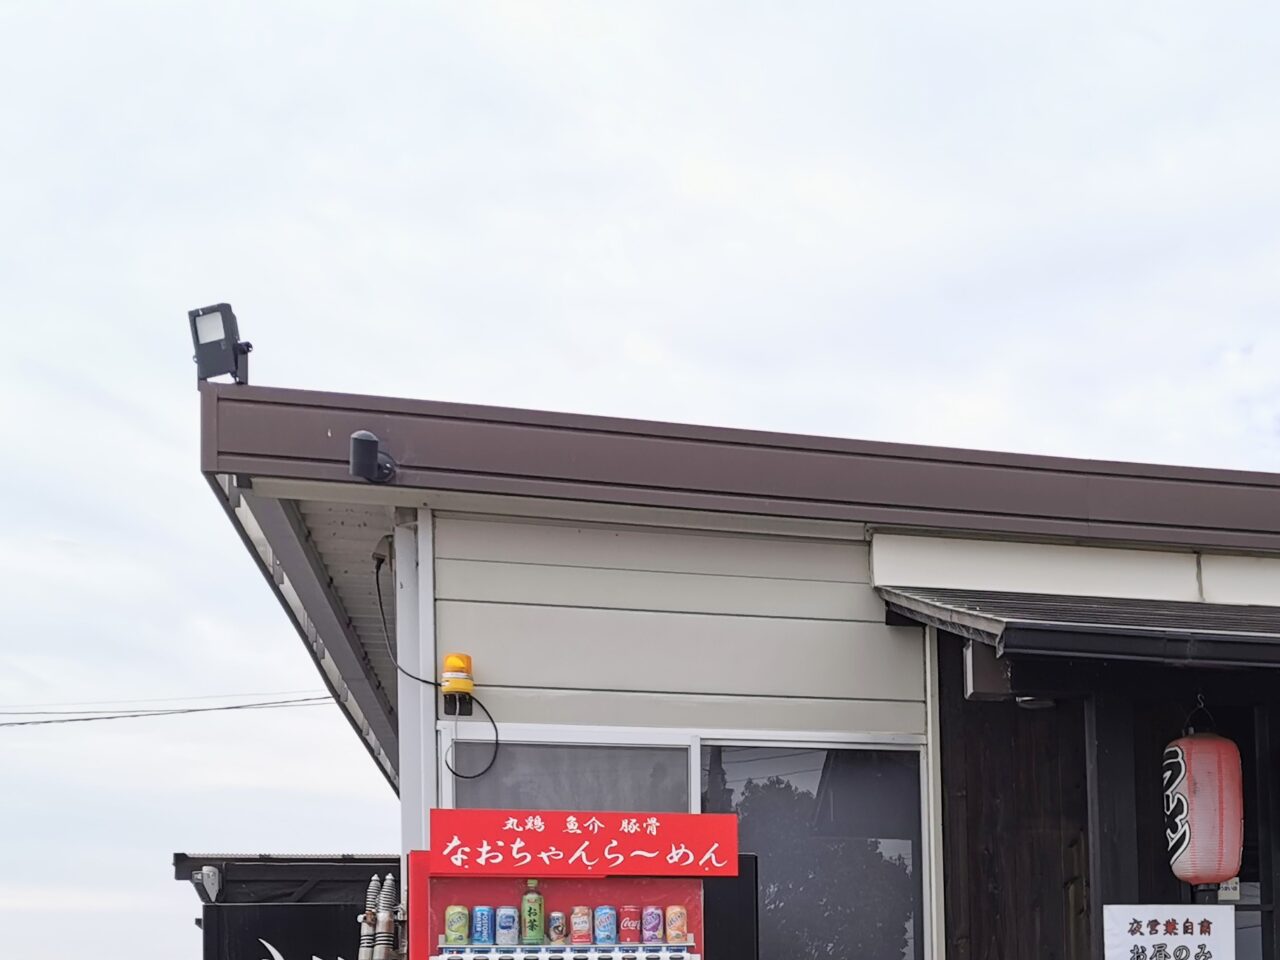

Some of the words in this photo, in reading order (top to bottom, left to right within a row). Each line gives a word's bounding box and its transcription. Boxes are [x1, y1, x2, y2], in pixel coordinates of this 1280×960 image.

[503, 815, 545, 833] 丸鶏
[562, 815, 606, 834] 魚介
[619, 816, 661, 836] 豚骨
[526, 905, 539, 932] お茶
[1127, 917, 1213, 936] 夜営業自粛
